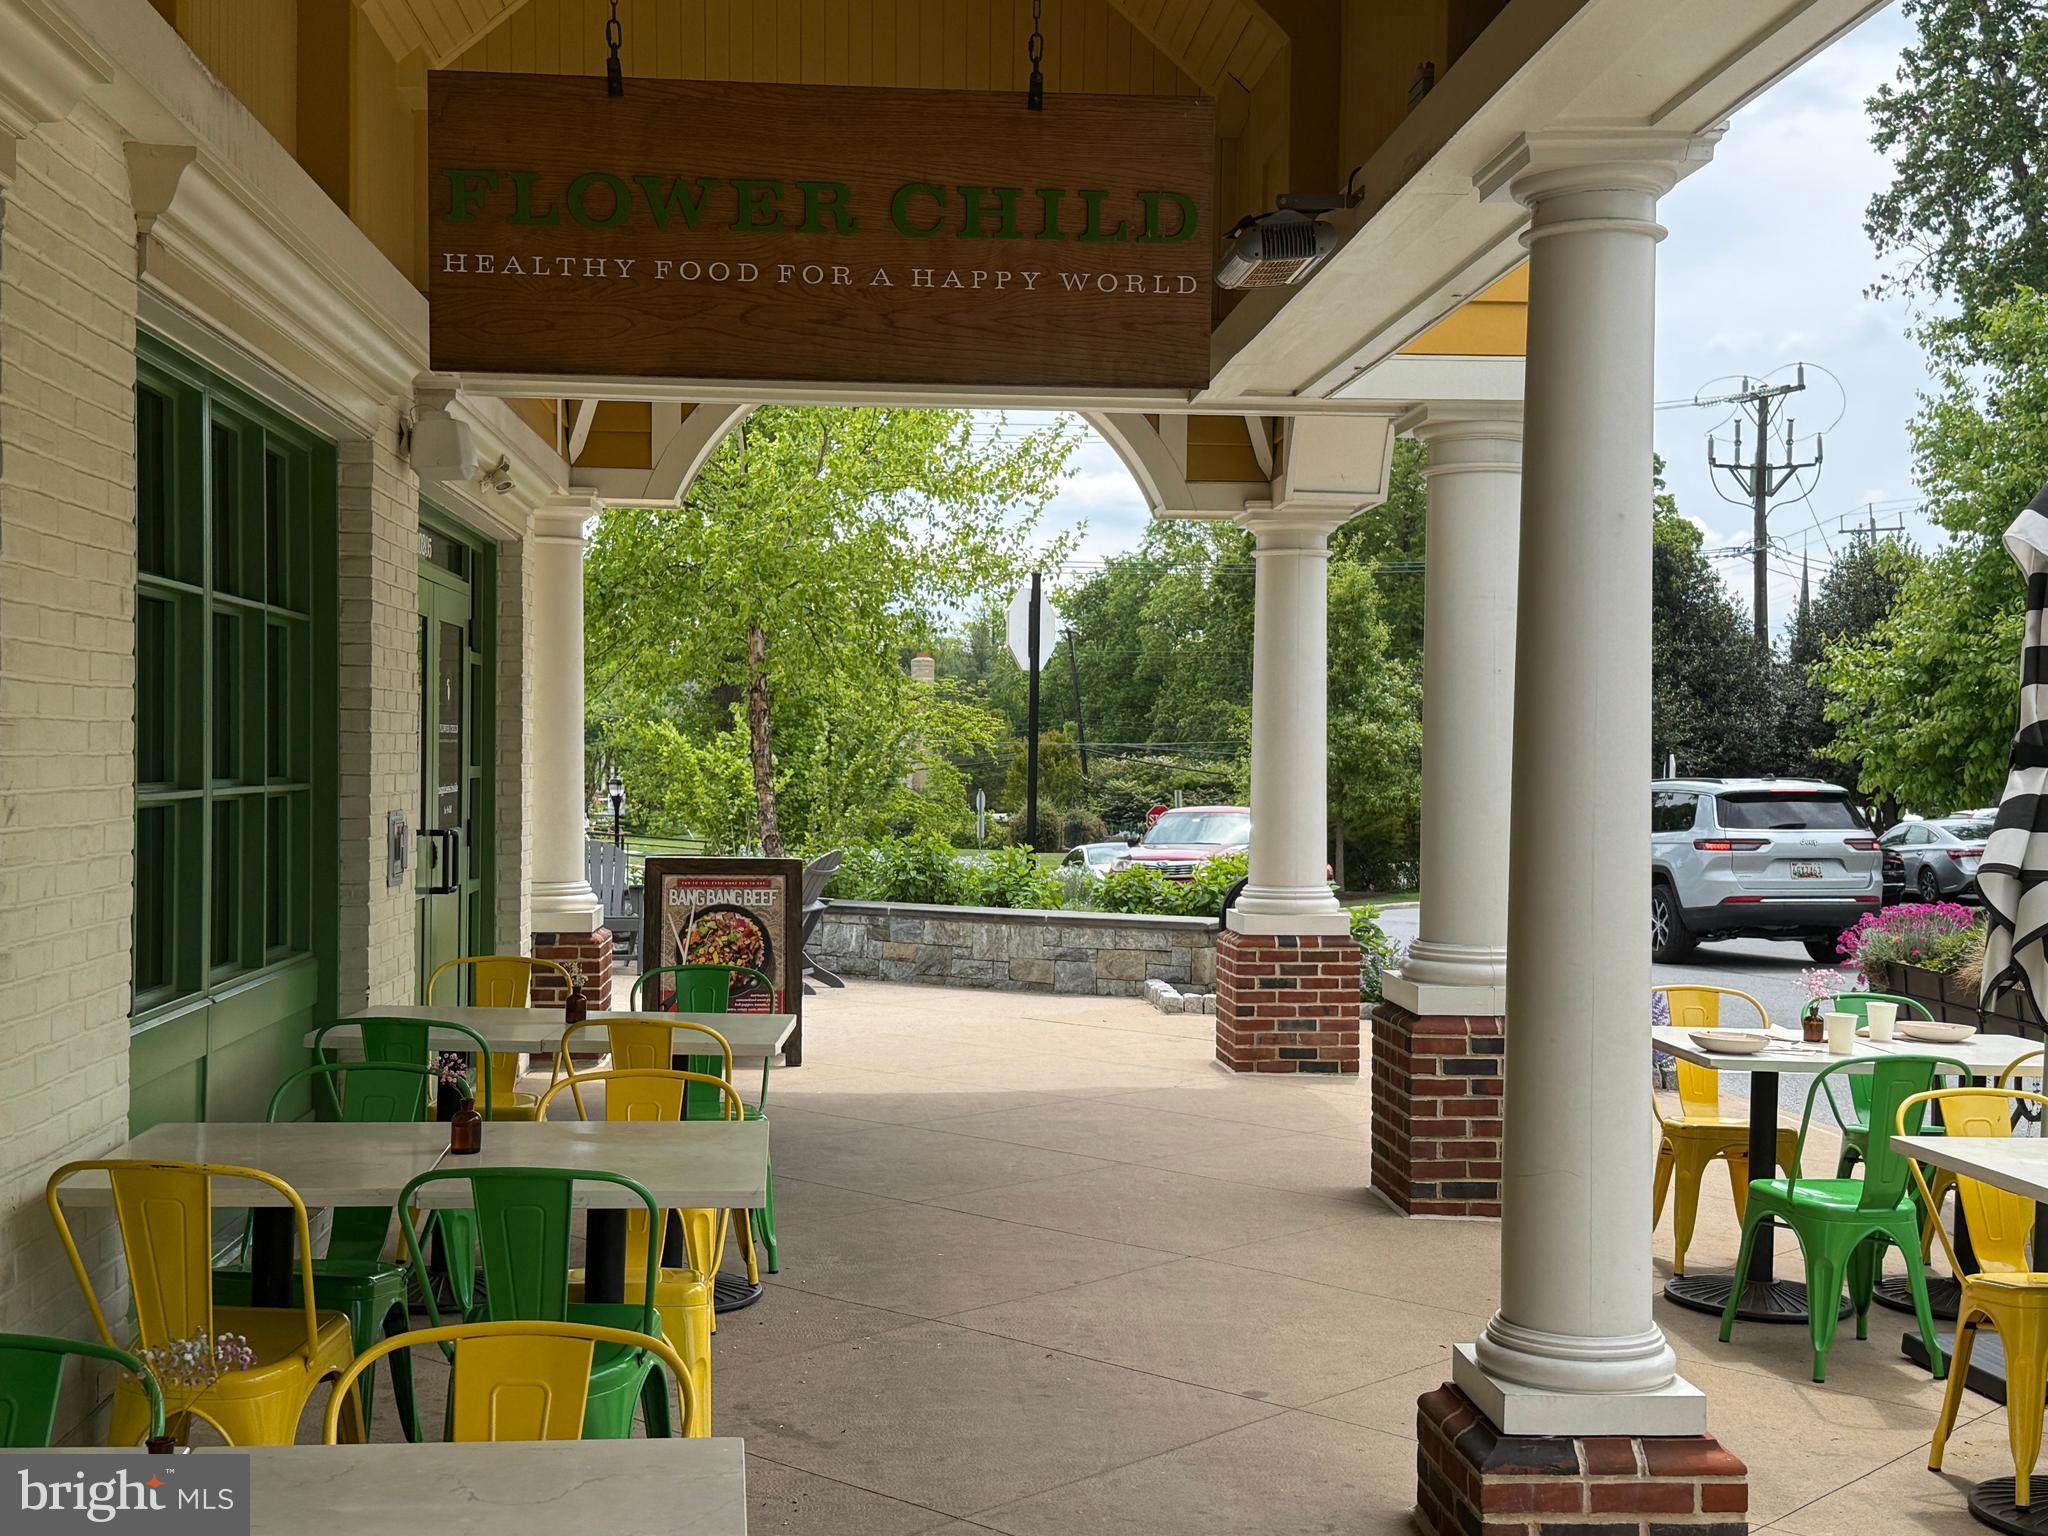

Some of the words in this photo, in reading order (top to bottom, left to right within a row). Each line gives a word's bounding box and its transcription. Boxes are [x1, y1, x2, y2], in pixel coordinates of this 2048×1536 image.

[442, 167, 859, 236] FLOWER
[890, 181, 1199, 243] CHILD
[443, 253, 635, 278] HEALTHY
[654, 260, 759, 283] FOOD
[777, 264, 853, 285] FOR
[869, 267, 894, 287] A
[911, 268, 1041, 291] HAPPY
[1058, 272, 1198, 294] WORLD
[669, 889, 705, 906] BANG
[706, 889, 742, 906] BANG
[743, 889, 778, 906] BEEF
